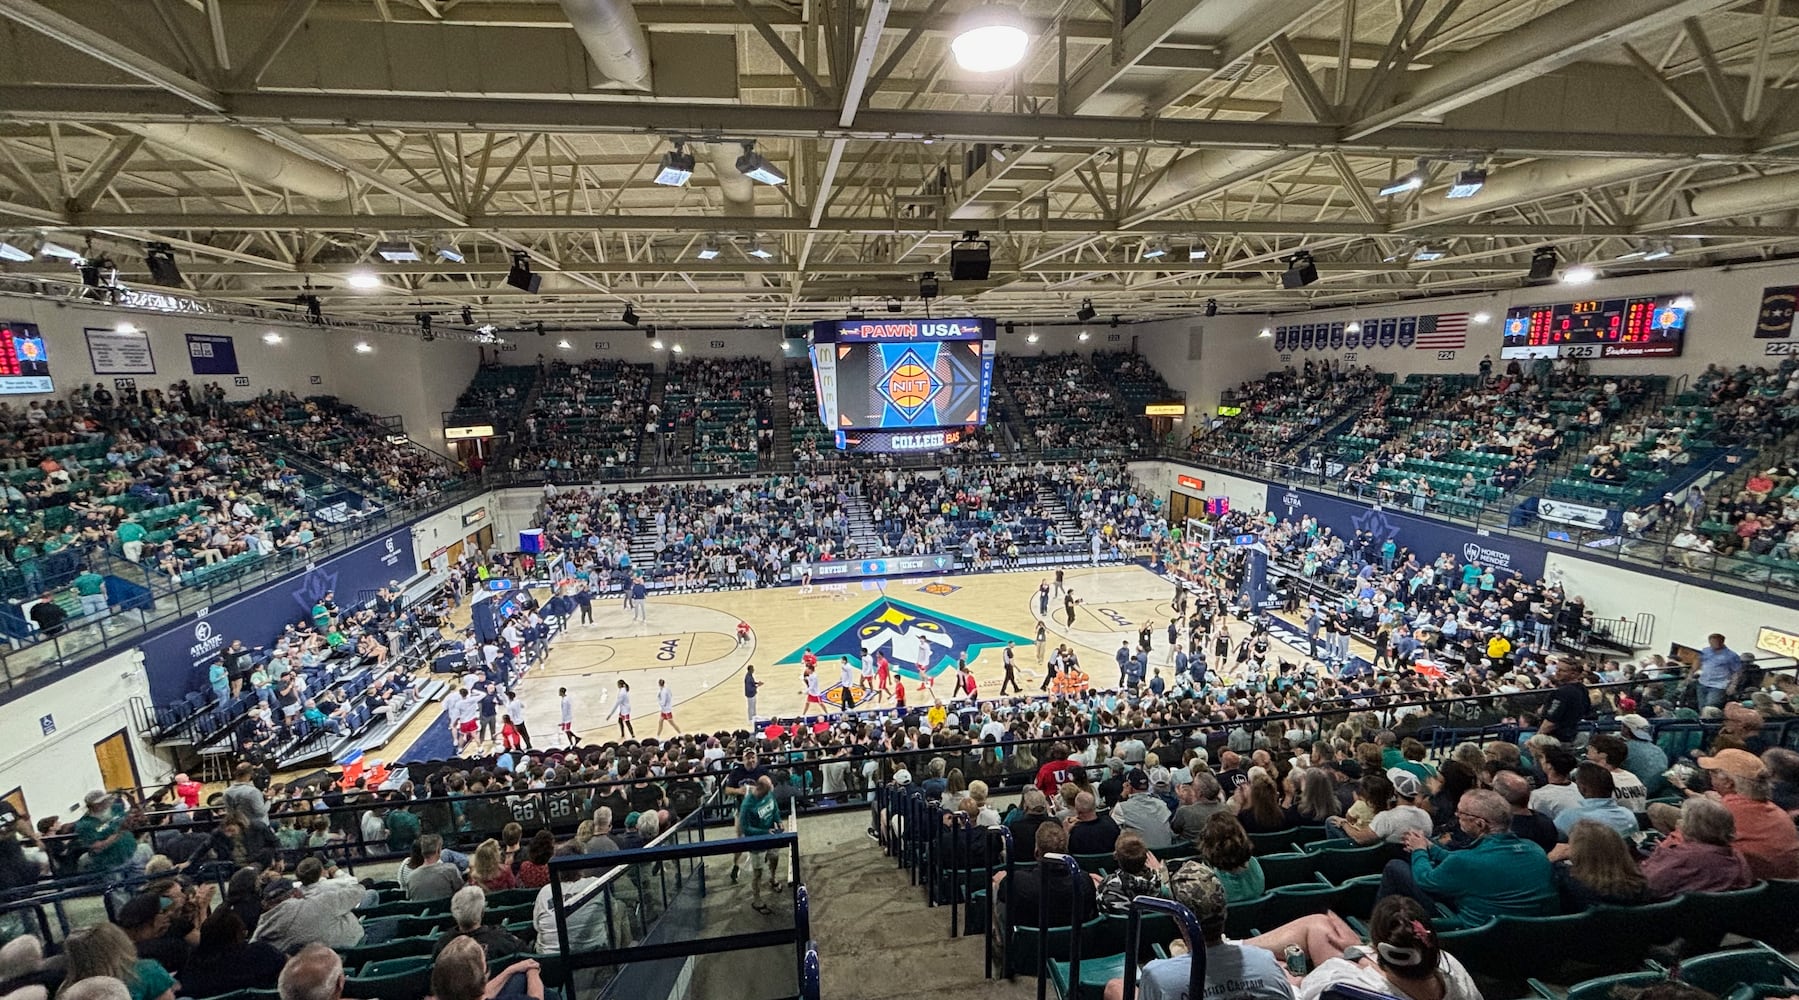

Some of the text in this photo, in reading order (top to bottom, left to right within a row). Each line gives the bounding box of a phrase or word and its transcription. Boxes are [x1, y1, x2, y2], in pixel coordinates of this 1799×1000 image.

[861, 324, 962, 337] PAWN USA
[1438, 352, 1455, 360] 224
[1568, 347, 1593, 356] 225
[116, 379, 135, 389] 212
[235, 377, 248, 386] 213
[892, 380, 929, 393] NIT
[981, 361, 991, 422] CAPITAL
[891, 433, 944, 449] COLLEGE
[1283, 496, 1301, 507] ULTRA
[1481, 548, 1511, 560] HORTON
[901, 560, 924, 569] UNCW
[1480, 555, 1509, 567] MENDEZ
[818, 564, 848, 575] DAYTON
[197, 606, 209, 618] 107
[1098, 608, 1133, 627] CAA
[190, 633, 223, 656] ATLANTIC
[656, 638, 681, 661] CAA
[1466, 705, 1481, 720] 26
[513, 802, 535, 821] 26
[549, 799, 570, 817] 26
[1226, 979, 1264, 992] CAPTAIN
